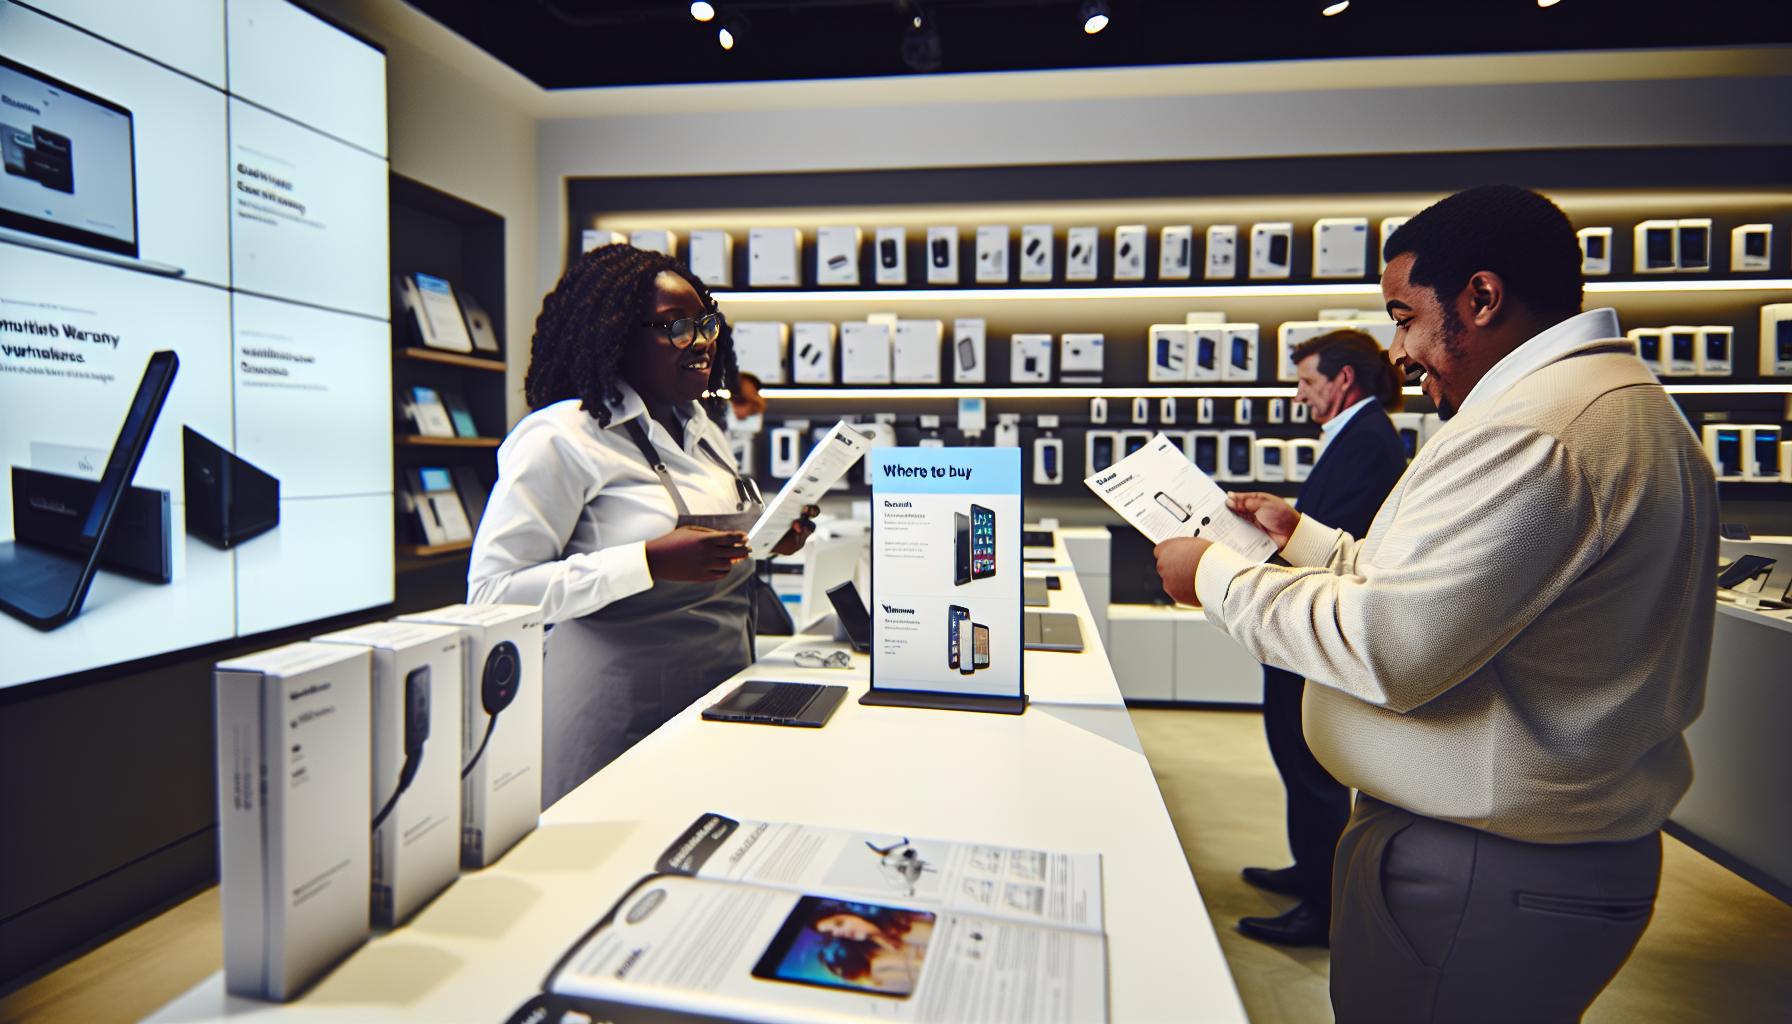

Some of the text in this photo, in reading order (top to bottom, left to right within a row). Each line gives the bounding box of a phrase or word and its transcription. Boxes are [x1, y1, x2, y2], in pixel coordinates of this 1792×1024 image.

[883, 463, 973, 481] Where to buy
